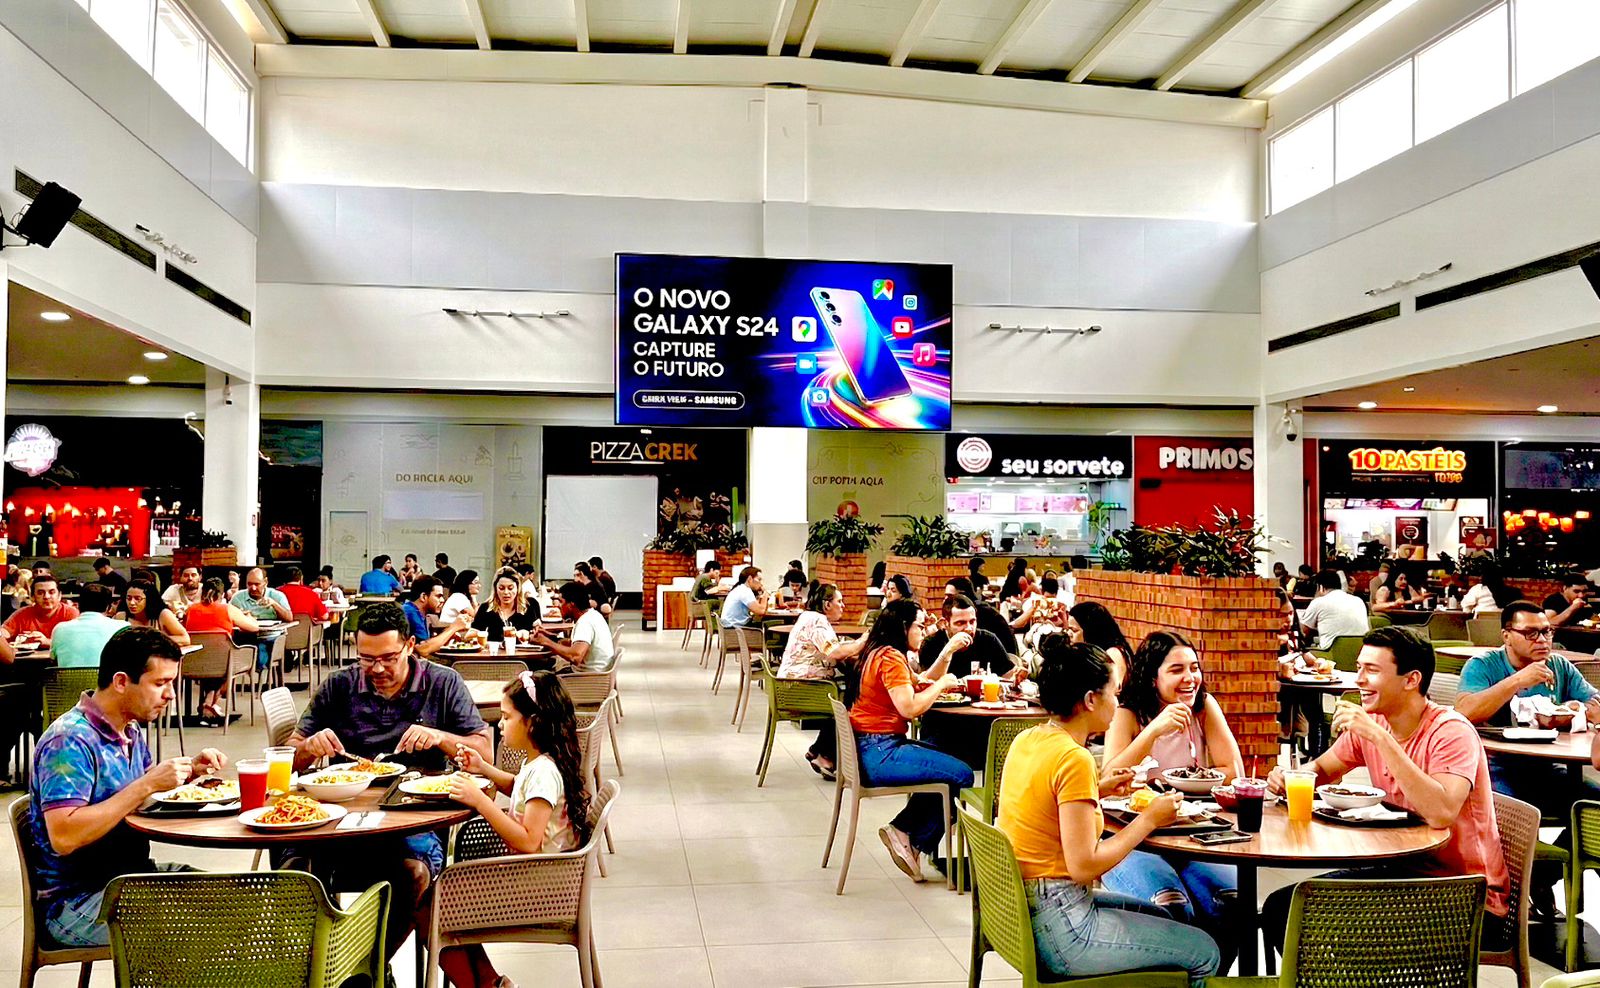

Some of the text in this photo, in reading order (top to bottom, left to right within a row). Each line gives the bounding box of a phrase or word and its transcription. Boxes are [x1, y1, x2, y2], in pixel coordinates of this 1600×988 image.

[633, 287, 731, 311] O NOVO
[633, 312, 779, 337] GALAXY S24
[633, 340, 716, 359] CAPTURE
[633, 360, 725, 378] O FUTURO
[694, 396, 737, 405] SAMSUNG
[1001, 457, 1125, 476] seu sorvete
[1159, 446, 1254, 471] PRIMOS
